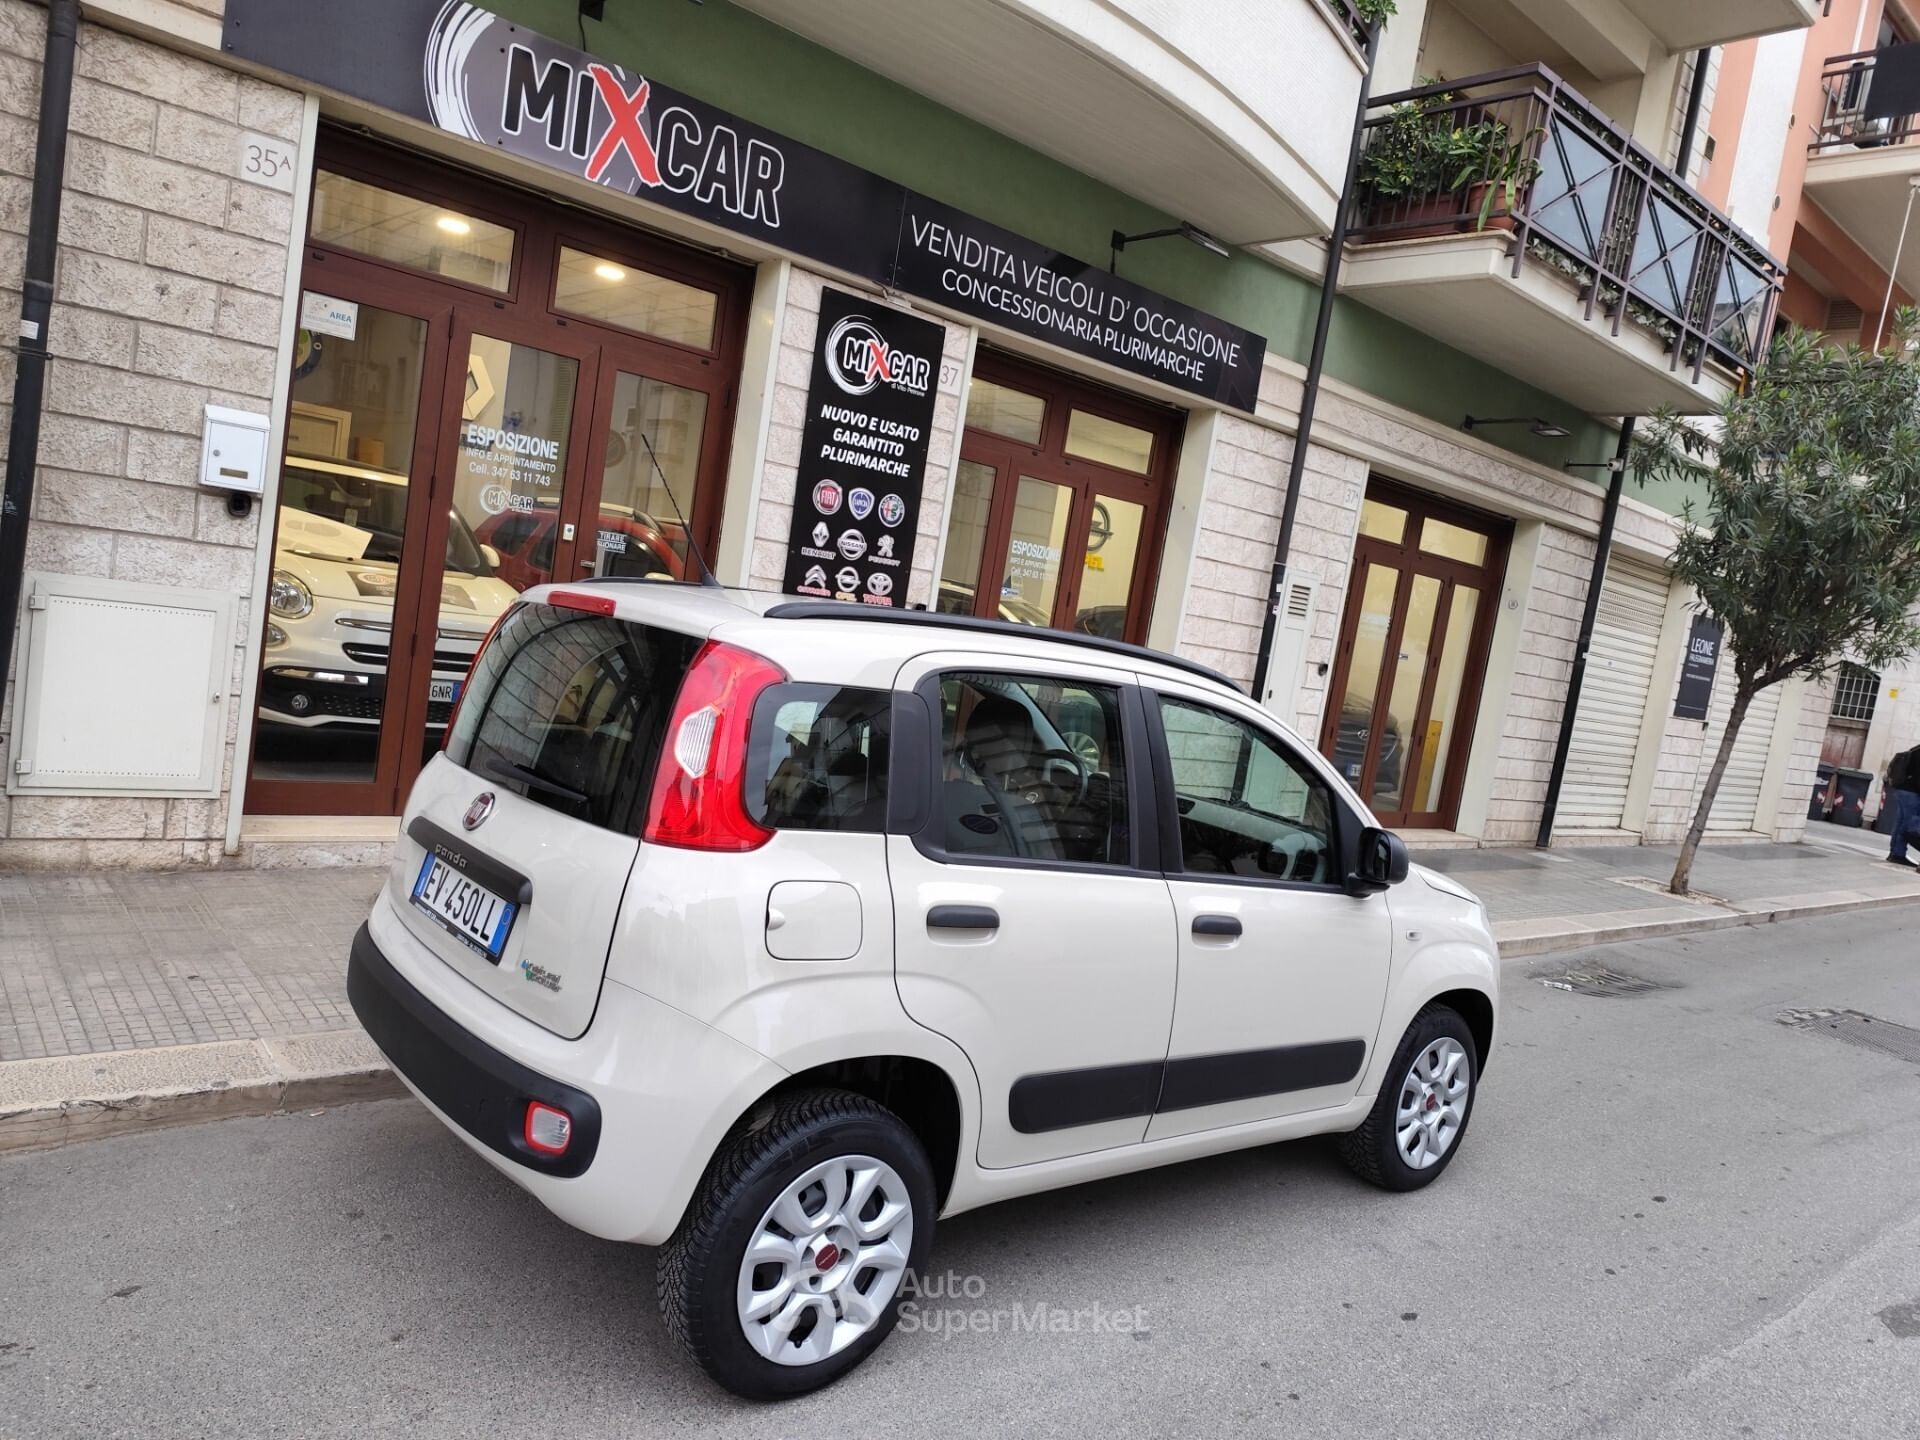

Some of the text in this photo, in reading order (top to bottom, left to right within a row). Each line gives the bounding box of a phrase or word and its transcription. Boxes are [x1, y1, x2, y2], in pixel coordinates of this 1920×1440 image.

[502, 42, 785, 228] MIXCAR
[911, 215, 1240, 367] VENDITA VEICOLI D' OCCASIONE
[330, 311, 352, 323] AREA
[942, 268, 1206, 382] CONCESSIONARIA PLURIMARCHE
[843, 337, 930, 390] MIXCAR
[940, 365, 958, 387] 37
[820, 404, 920, 442] NUOVO E USATO
[467, 424, 560, 460] ESPOSIZIONE
[833, 427, 905, 457] GARANTITO
[465, 447, 556, 473] INFO E APPUNTAMENTO
[469, 461, 490, 476] Cell.
[491, 465, 508, 478] 347
[523, 471, 532, 483] 11
[535, 474, 551, 487] 743
[820, 444, 911, 478] PLURIMARCHE
[821, 489, 836, 505] FIAT
[801, 546, 836, 560] RENAULT
[840, 540, 864, 549] NISSAN
[1691, 637, 1715, 656] LEONE
